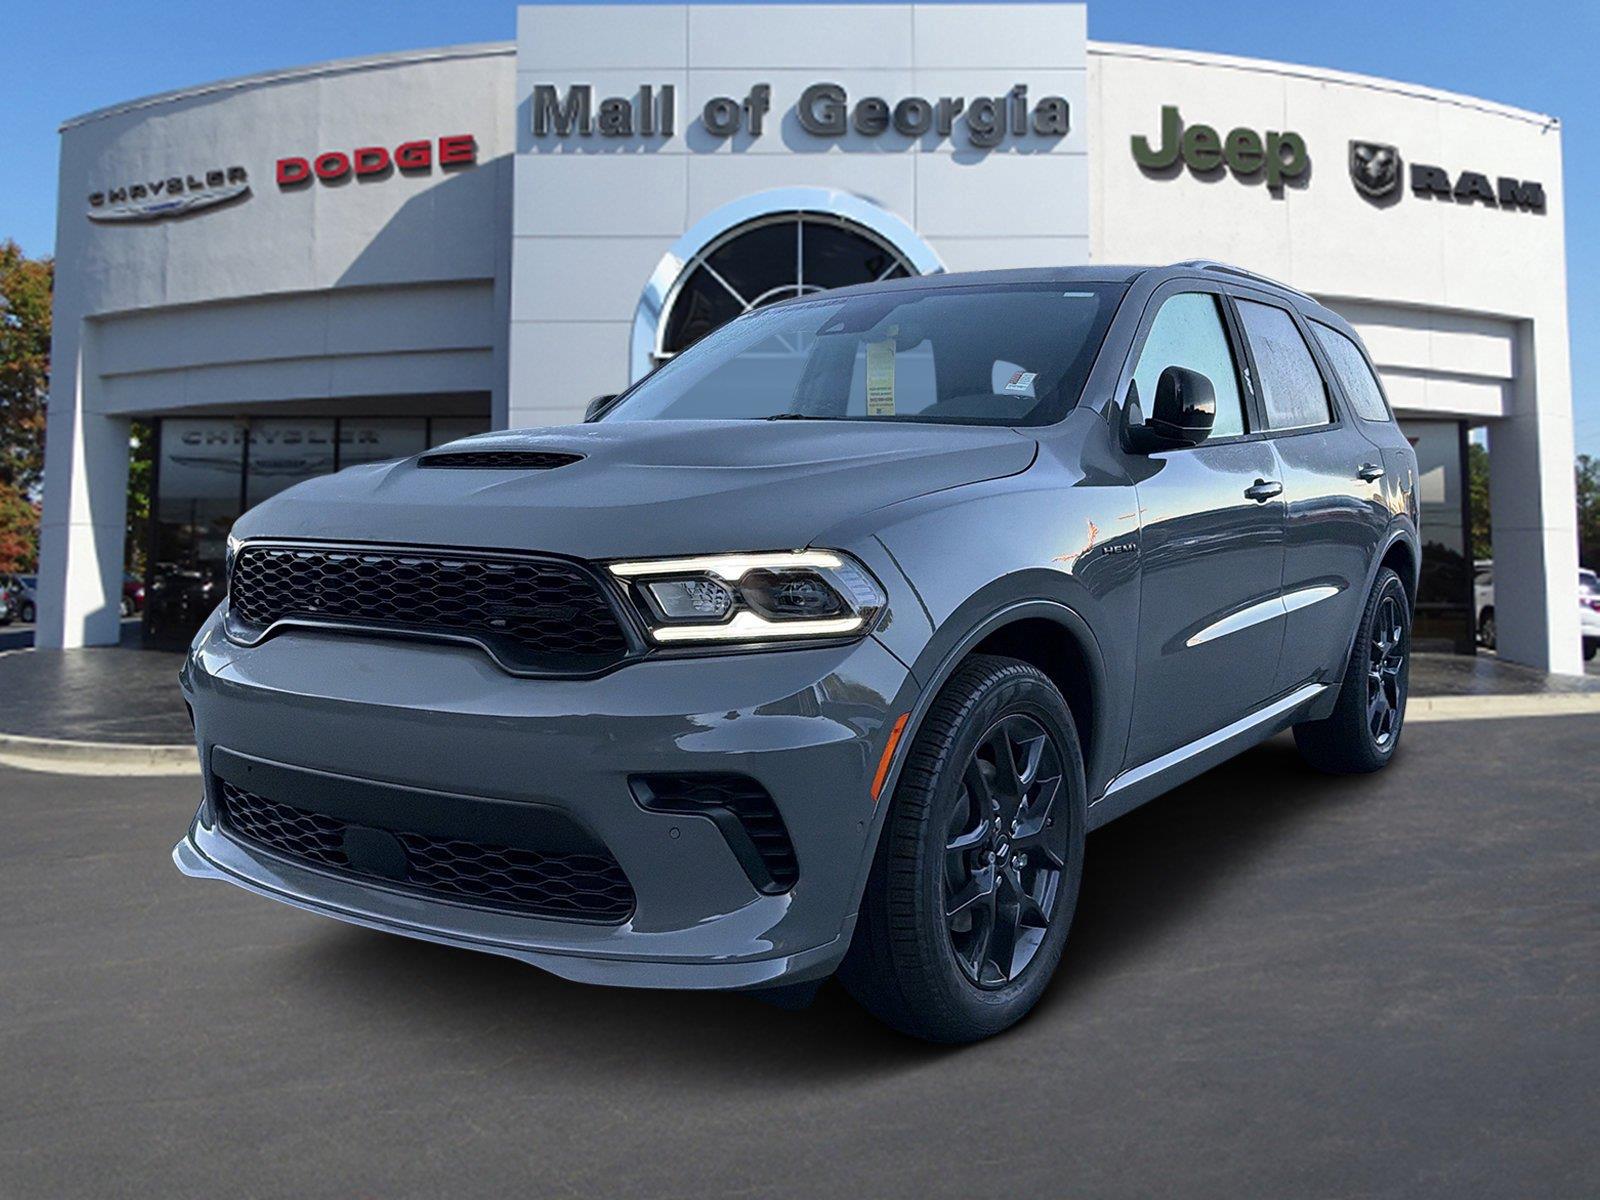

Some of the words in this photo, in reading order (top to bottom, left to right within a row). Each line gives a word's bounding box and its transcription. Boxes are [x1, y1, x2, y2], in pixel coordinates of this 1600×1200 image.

[531, 84, 676, 137] Mall
[702, 83, 771, 136] of
[797, 83, 1071, 148] Georgia
[276, 134, 476, 187] DODGE
[1131, 105, 1307, 190] Jeep
[88, 166, 248, 207] CHRYSLER
[1410, 163, 1546, 214] RAM
[181, 431, 379, 445] CHRYSLER
[1102, 543, 1137, 555] HEMI
